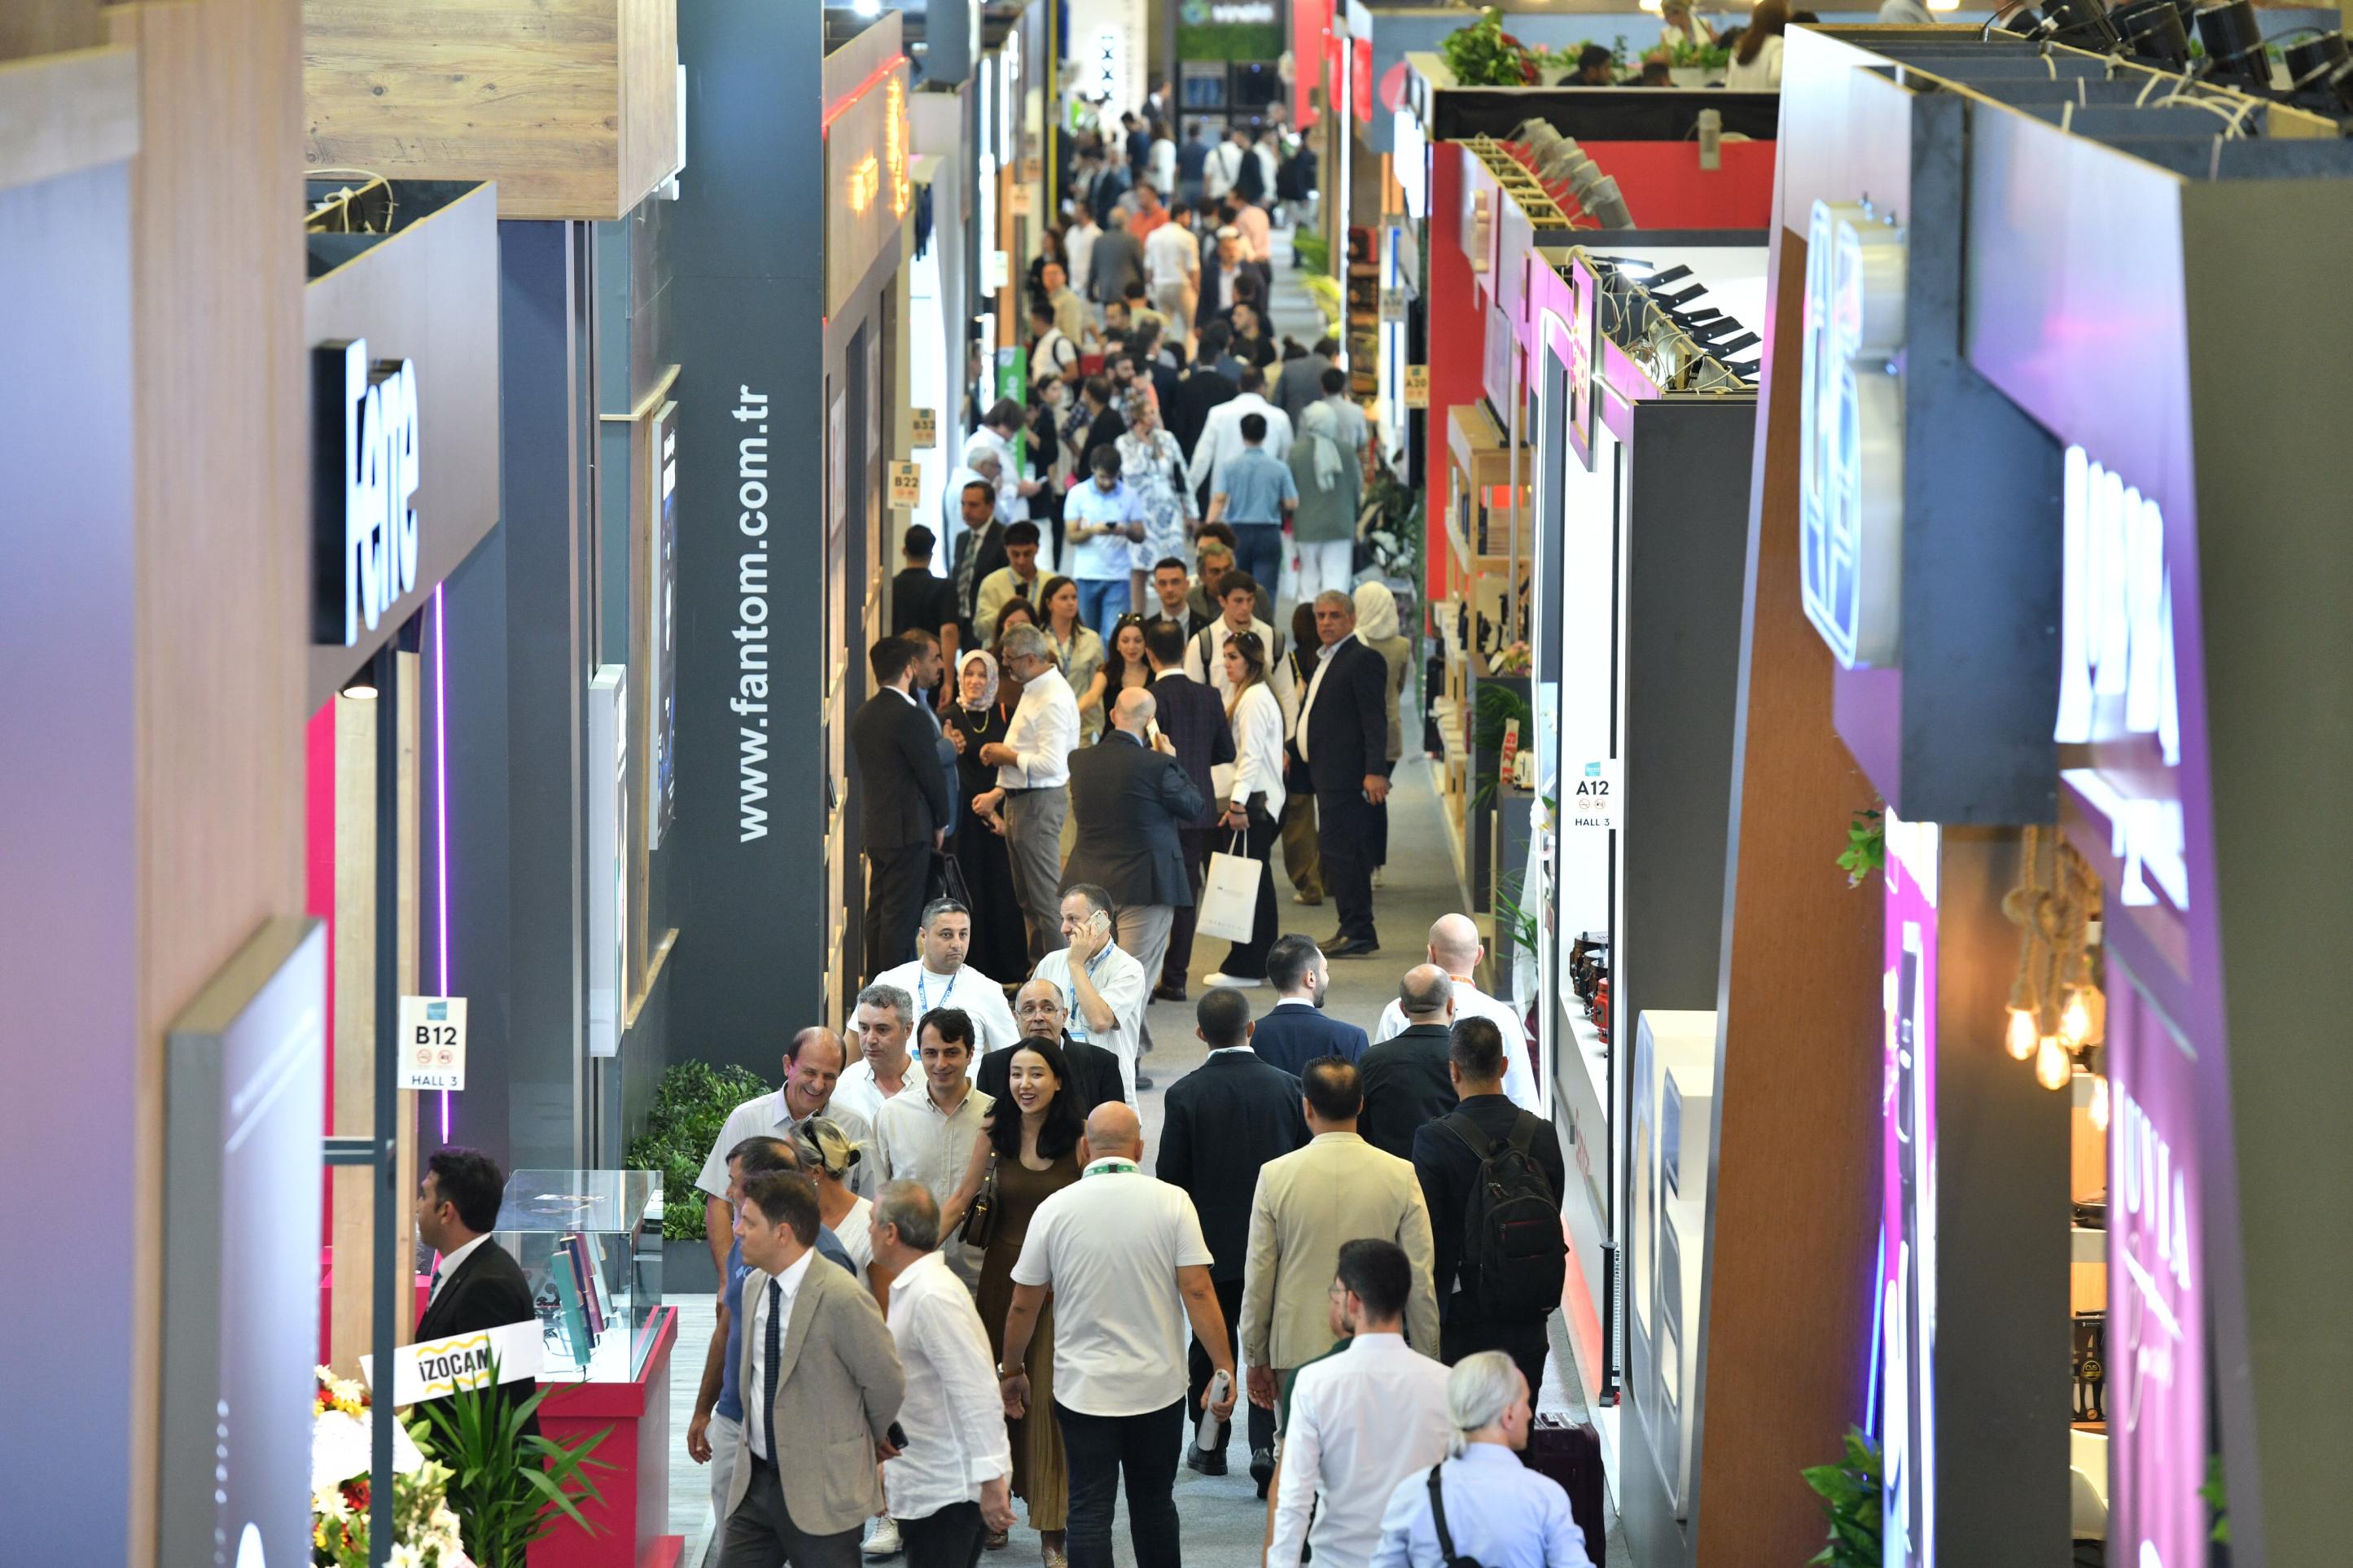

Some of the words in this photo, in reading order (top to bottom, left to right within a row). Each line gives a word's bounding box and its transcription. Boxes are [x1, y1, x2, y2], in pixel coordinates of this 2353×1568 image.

[895, 477, 918, 487] B22
[730, 383, 769, 843] www.fantom.com.tr
[1576, 781, 1609, 795] A12
[416, 1026, 456, 1045] B12
[412, 1075, 445, 1086] HALL
[450, 1076, 457, 1086] 3
